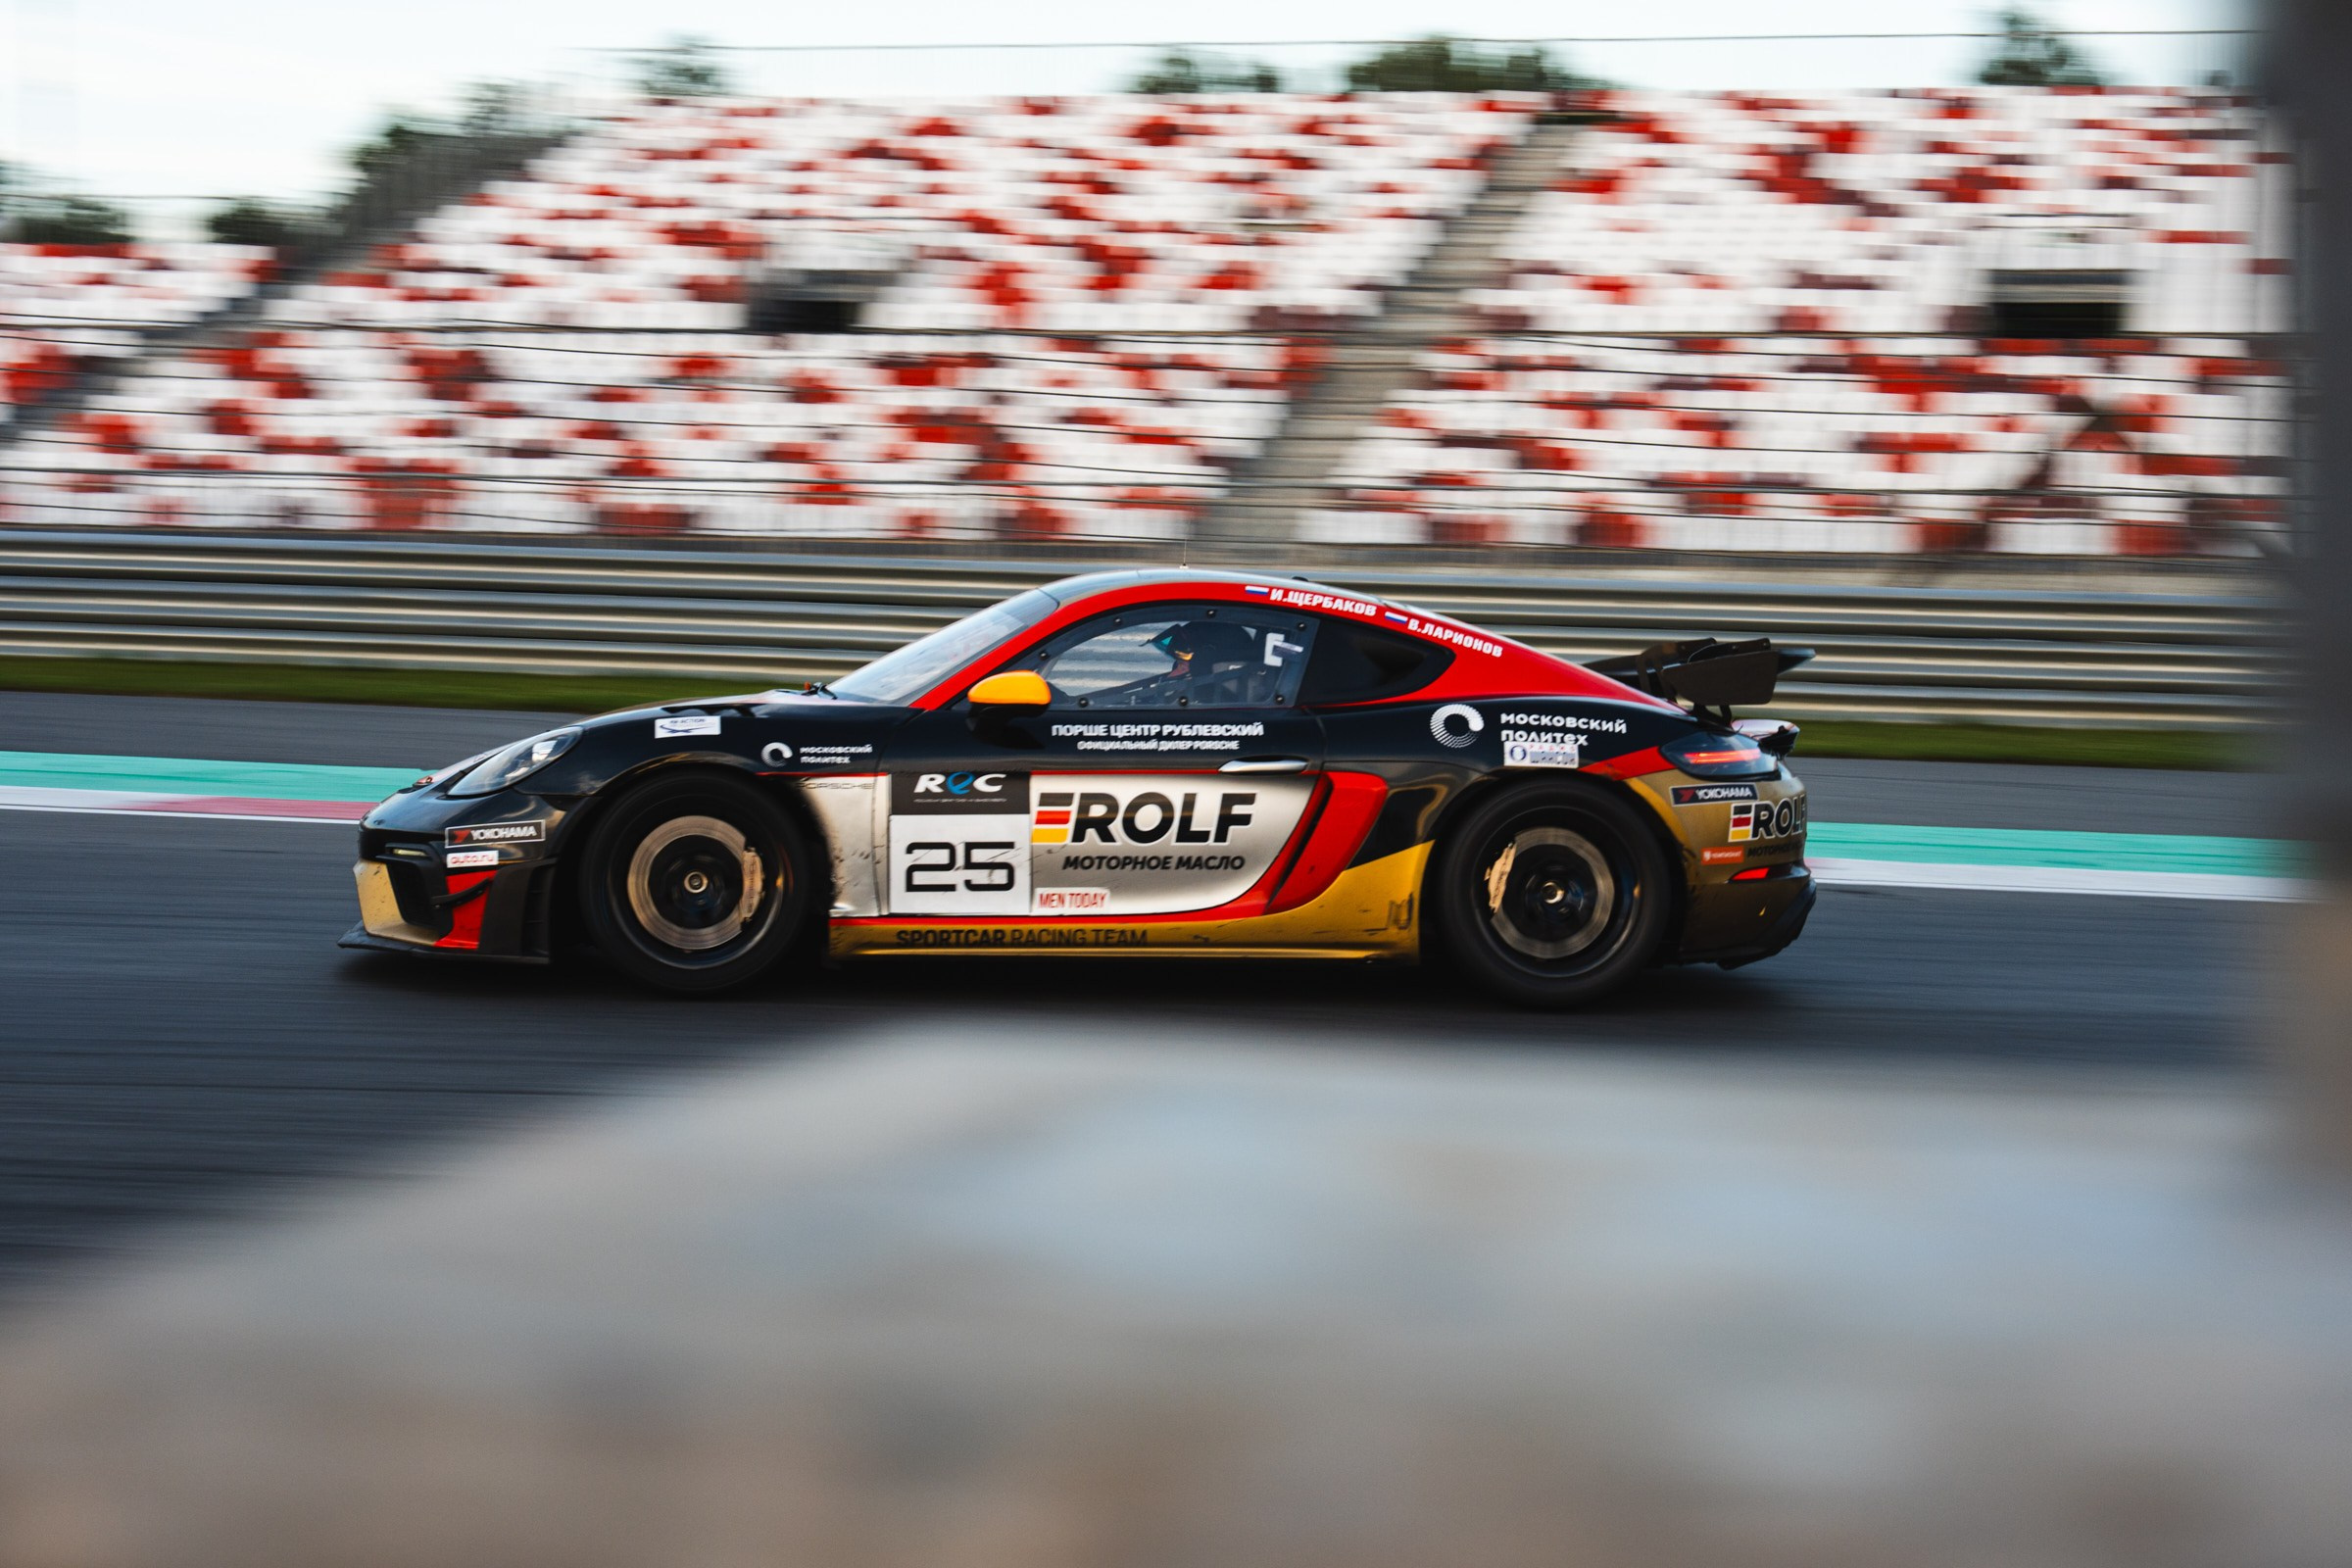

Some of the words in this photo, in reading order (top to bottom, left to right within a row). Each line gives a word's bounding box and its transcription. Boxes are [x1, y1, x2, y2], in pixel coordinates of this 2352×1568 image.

[1269, 588, 1377, 617] И.ЩЕРБАКОВ
[1407, 617, 1503, 659] В.ЛАРИОНОВ
[1052, 724, 1108, 736] ПОРШЕ
[1110, 724, 1161, 738] ЦЕНТР
[1162, 722, 1264, 736] РУБЛЕВСКИЙ
[1695, 787, 1752, 800] YOKOHAMA
[1072, 791, 1258, 844] ROLF
[470, 825, 538, 841] YOKOHAMA
[451, 854, 495, 865] auto.ru
[905, 841, 1016, 893] 25
[1061, 855, 1173, 871] МОТОРНОЕ
[1175, 855, 1246, 871] МАСЛО
[1039, 893, 1065, 908] MEN
[1068, 893, 1107, 908] TODAY
[896, 929, 1006, 948] SPORTCAR
[1009, 928, 1087, 947] RACING
[1089, 928, 1149, 947] TEAM
